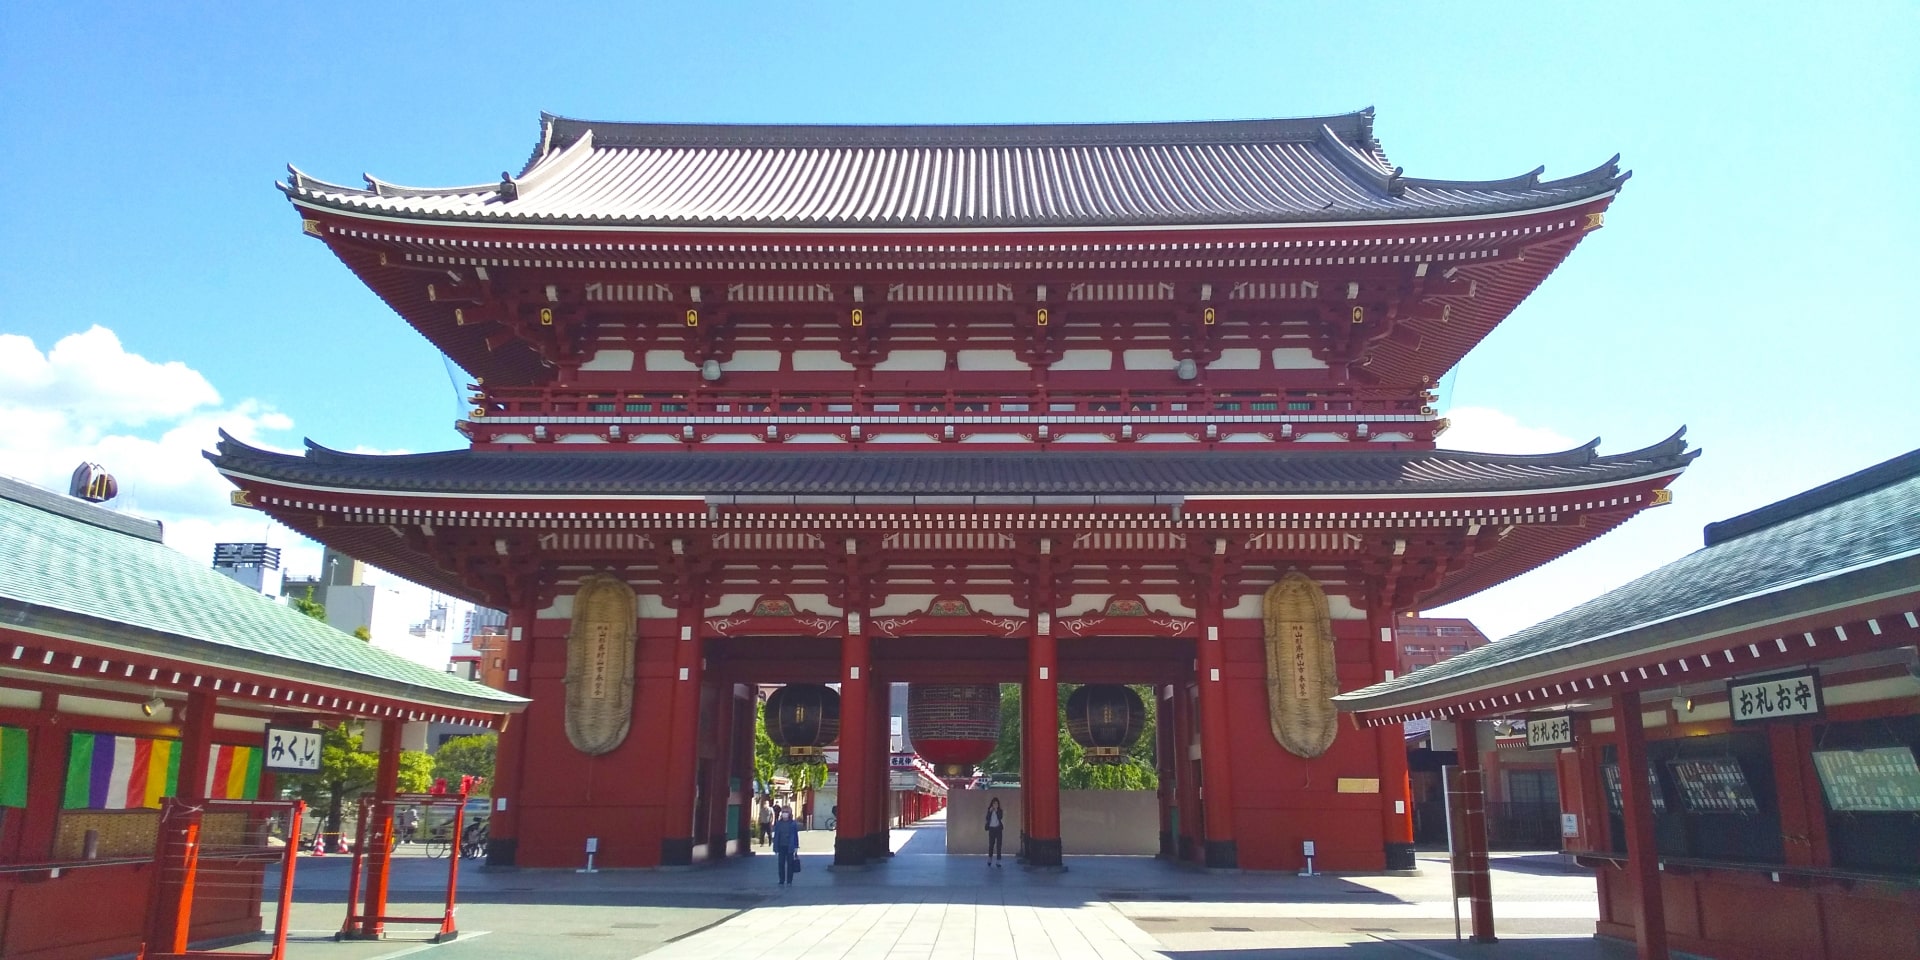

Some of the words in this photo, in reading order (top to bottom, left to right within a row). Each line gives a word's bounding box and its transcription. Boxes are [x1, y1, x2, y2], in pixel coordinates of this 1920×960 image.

[1740, 680, 1811, 716] お札お守
[1532, 719, 1569, 743] お札お守
[271, 735, 315, 762] みくじ
